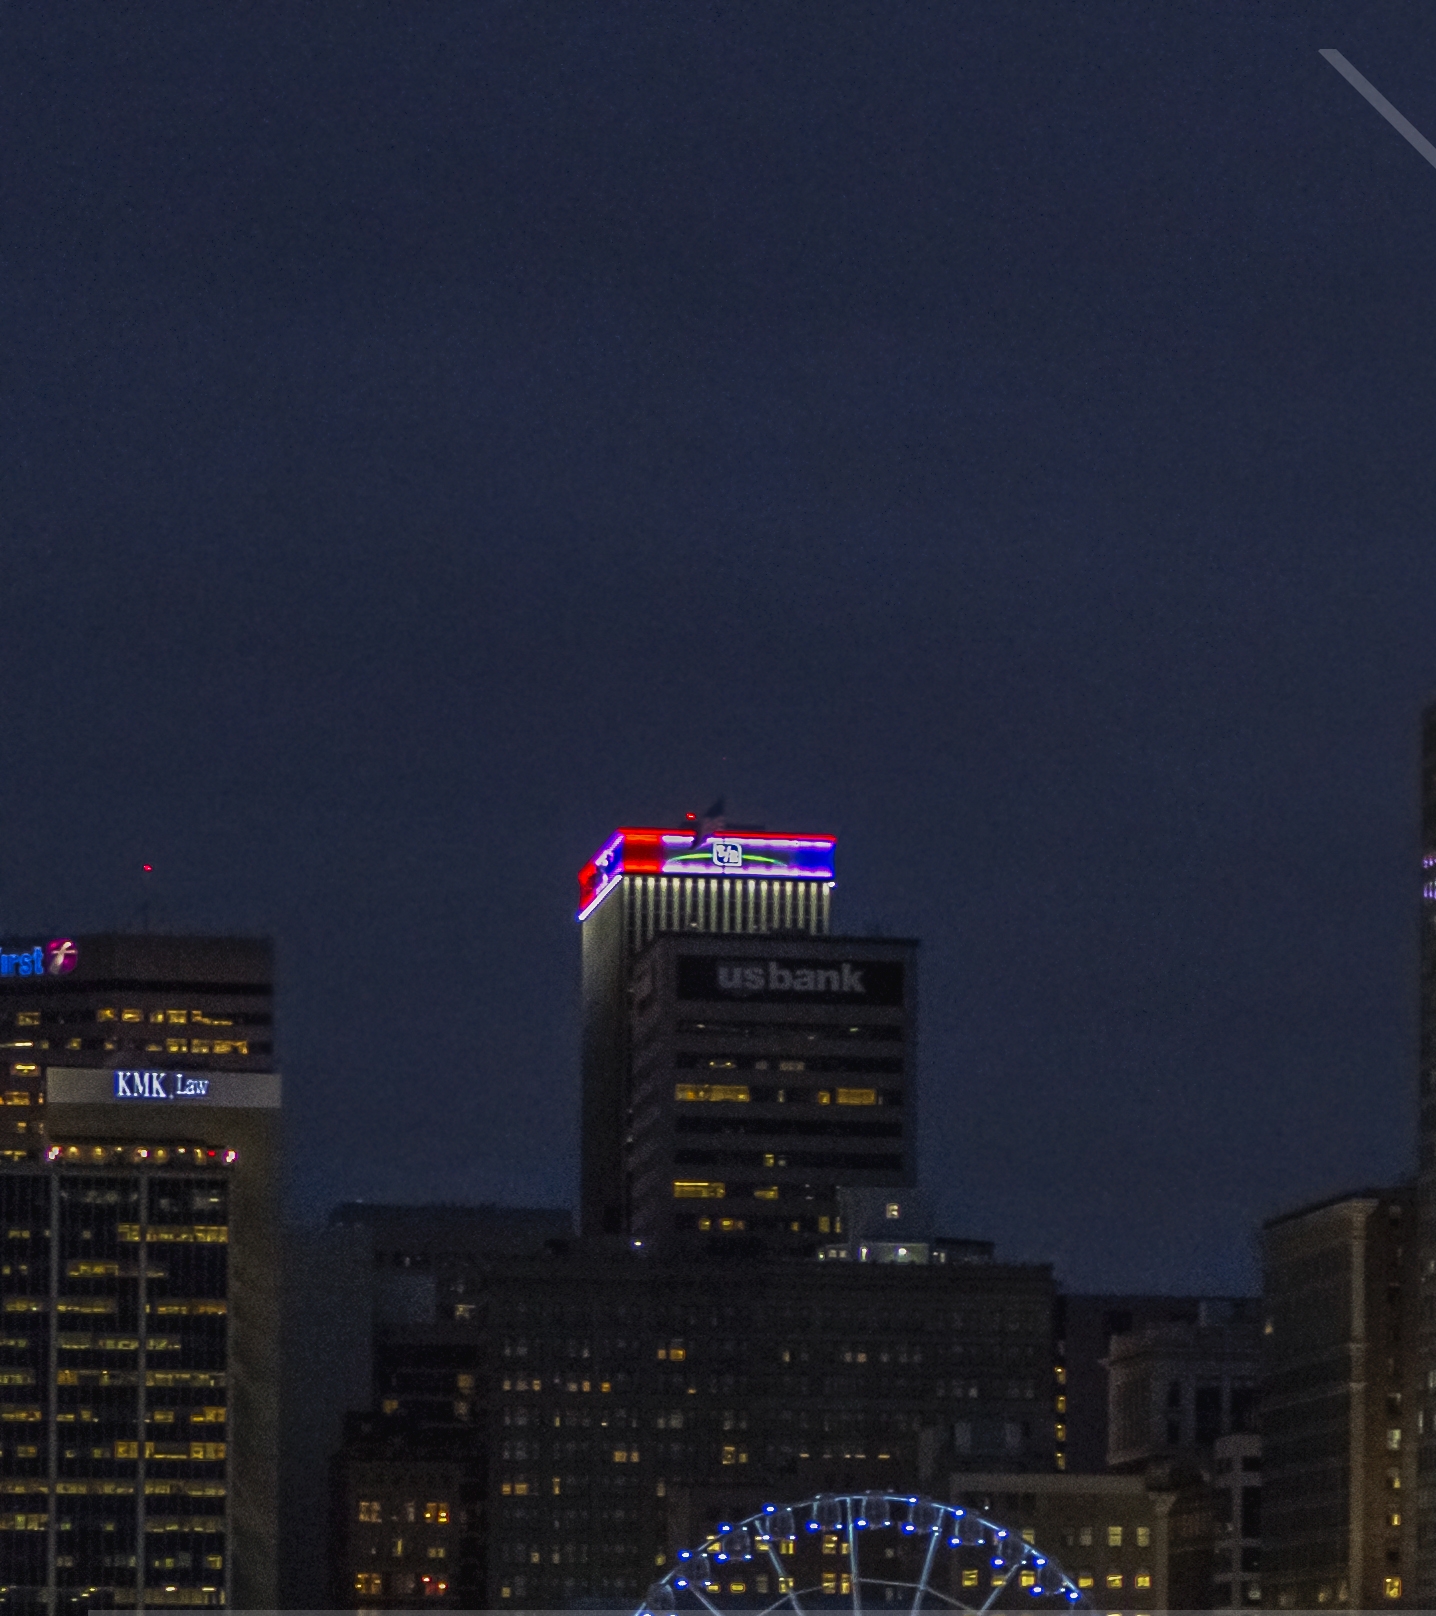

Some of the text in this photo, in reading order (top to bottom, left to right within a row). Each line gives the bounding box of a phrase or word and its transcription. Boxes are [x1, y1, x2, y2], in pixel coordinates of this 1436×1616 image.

[0, 946, 44, 976] irst
[117, 1071, 210, 1098] KMK Law
